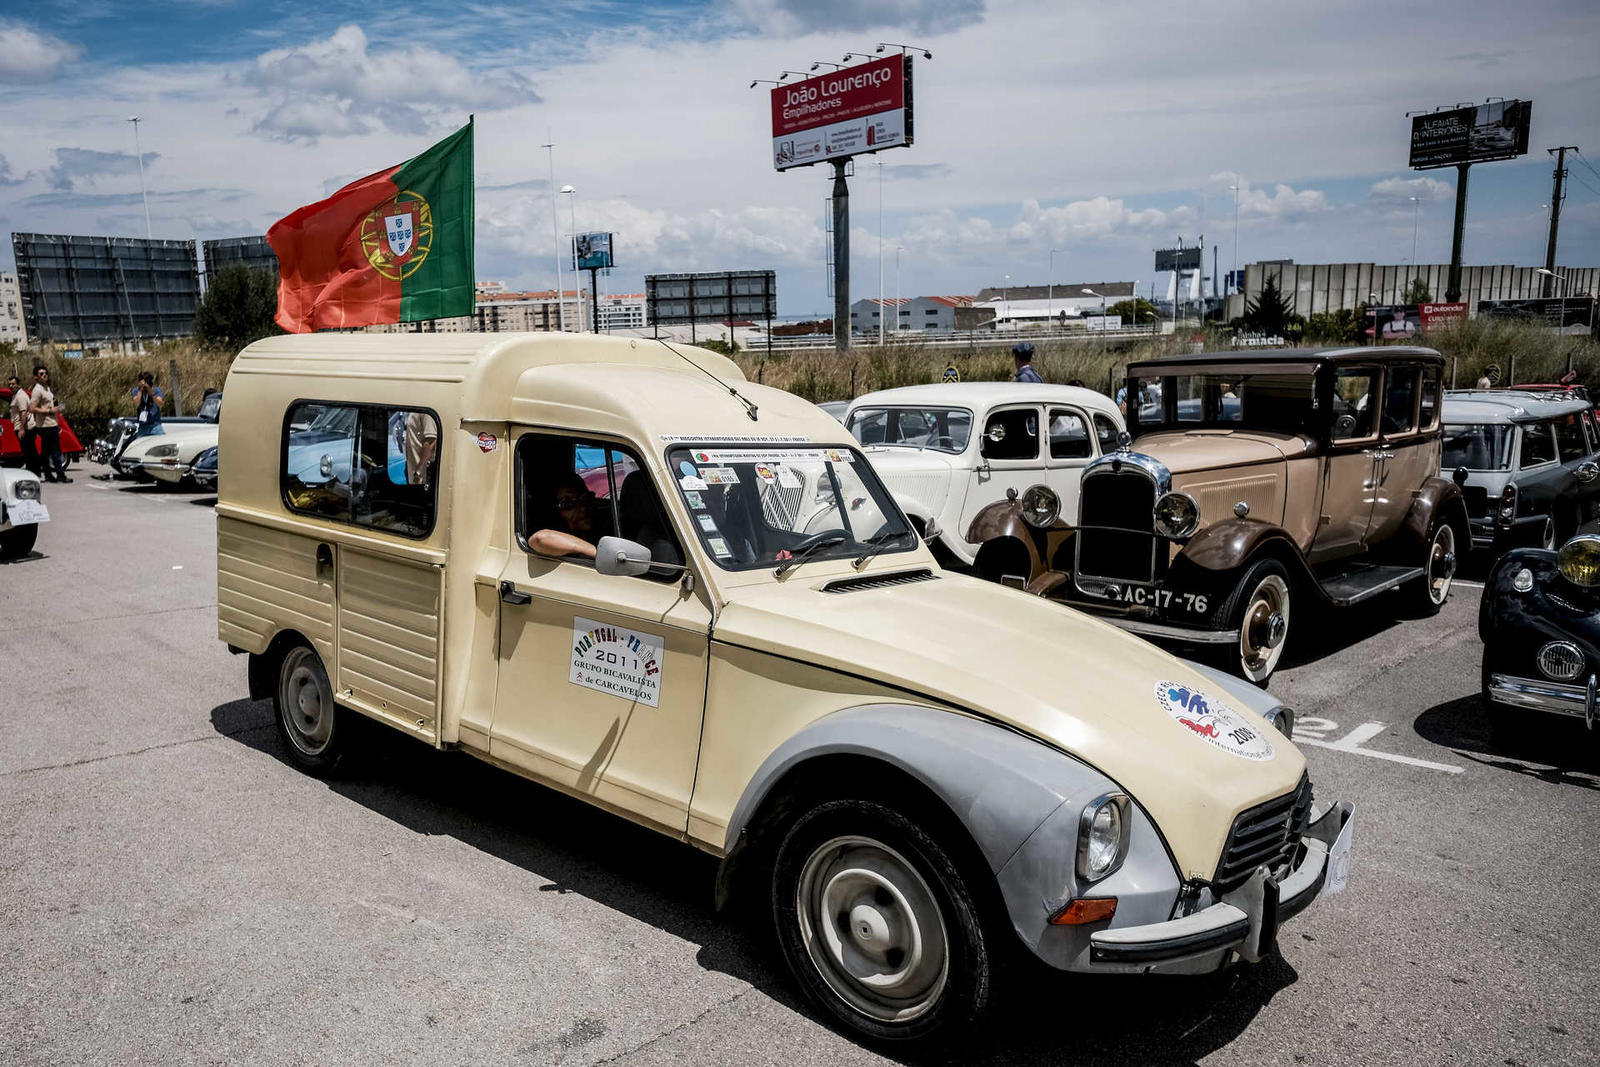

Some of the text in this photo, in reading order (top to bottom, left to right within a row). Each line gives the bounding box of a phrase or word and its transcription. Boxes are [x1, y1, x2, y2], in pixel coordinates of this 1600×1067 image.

[783, 67, 892, 108] João Lourenço
[783, 97, 842, 119] Empilhadores
[1124, 585, 1208, 613] AC-17-76
[575, 627, 659, 677] PORTUGAL FRANCE
[596, 649, 638, 670] 2011
[574, 660, 657, 689] GRUPO BICAVALISTA
[585, 676, 652, 701] de CARCAVELOS
[1228, 727, 1257, 746] 2009
